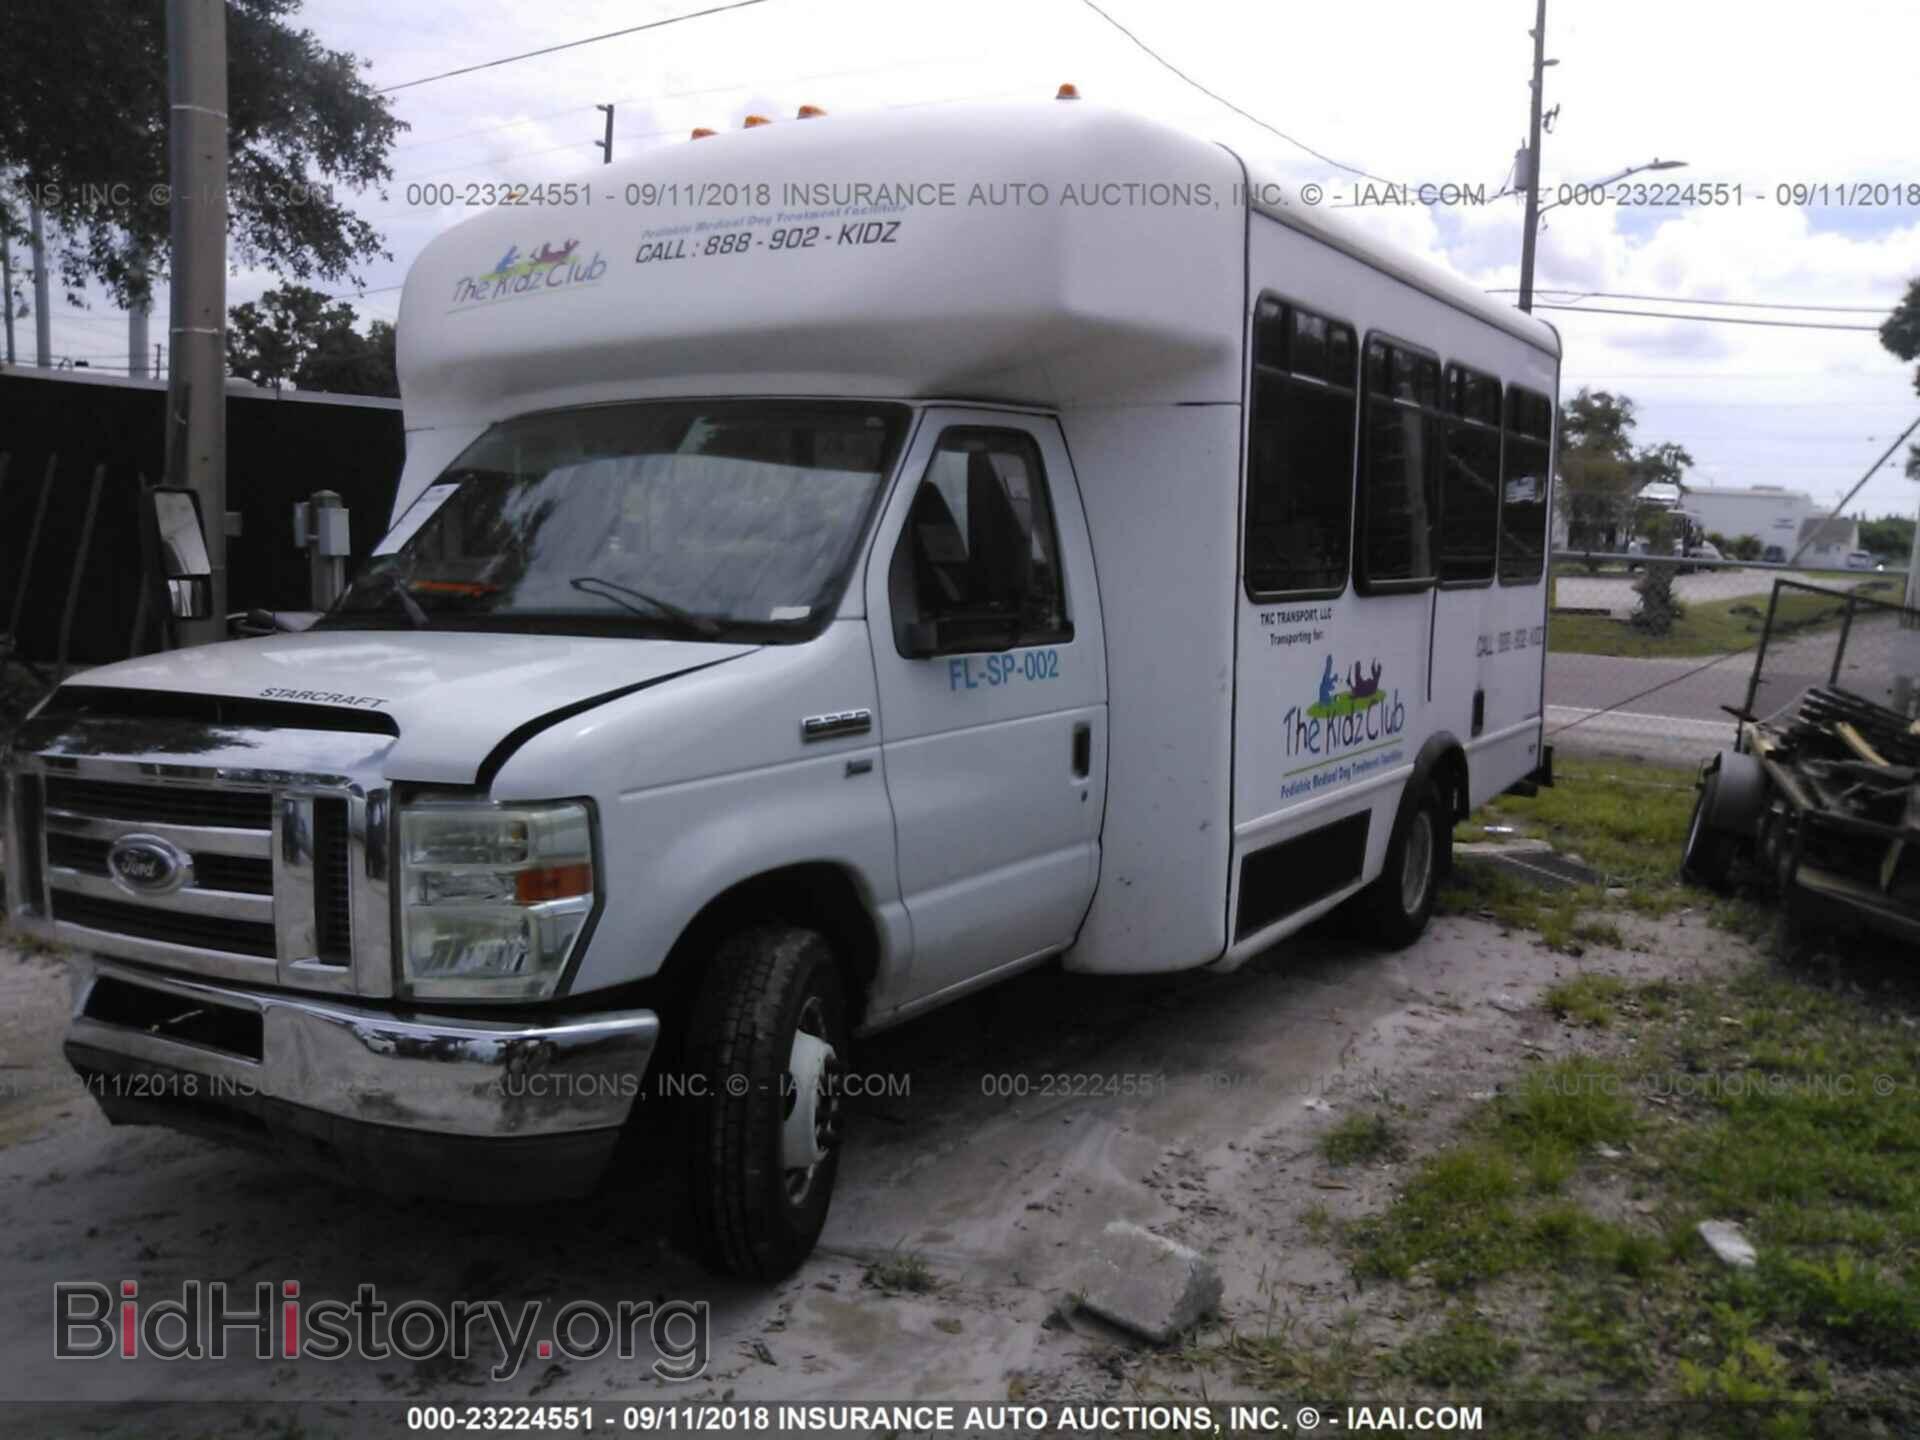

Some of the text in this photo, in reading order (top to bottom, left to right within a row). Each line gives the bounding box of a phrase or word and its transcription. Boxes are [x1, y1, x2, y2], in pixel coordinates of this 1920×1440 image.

[547, 251, 607, 288] Club
[948, 649, 1059, 691] FL-SP-002
[259, 687, 390, 709] STARCRAFT
[1282, 706, 1321, 756] The
[1366, 687, 1405, 741] Club
